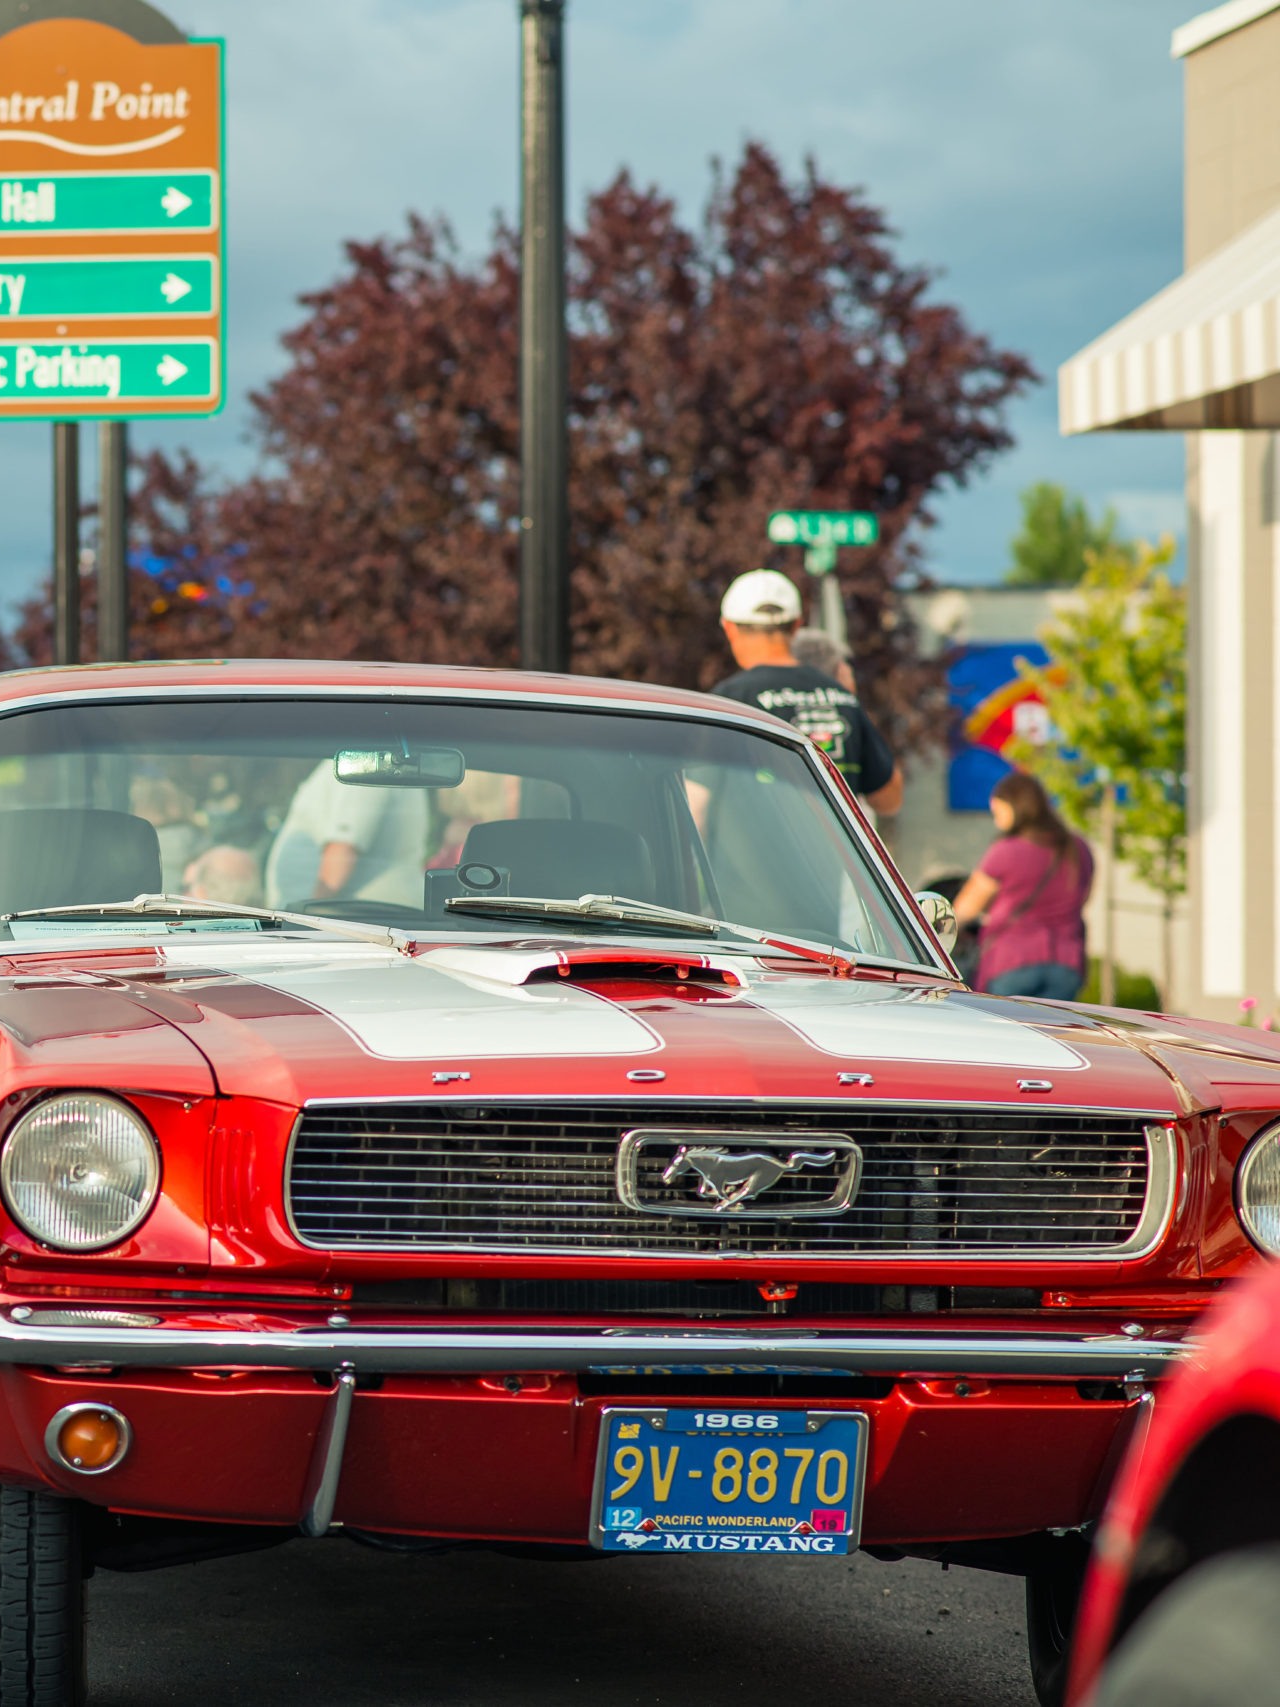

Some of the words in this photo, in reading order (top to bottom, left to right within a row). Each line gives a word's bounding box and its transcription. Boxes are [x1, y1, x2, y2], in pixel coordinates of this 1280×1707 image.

[90, 81, 191, 121] Point
[1, 181, 57, 223] Hall
[16, 344, 121, 400] Parking
[694, 1413, 779, 1429] 1966
[610, 1446, 849, 1505] 9V-8870
[611, 1509, 635, 1527] 12
[655, 1515, 703, 1526] PACIFIC
[706, 1515, 797, 1528] WONDERLAND
[821, 1519, 837, 1530] 19
[663, 1534, 835, 1552] MUSTANG
